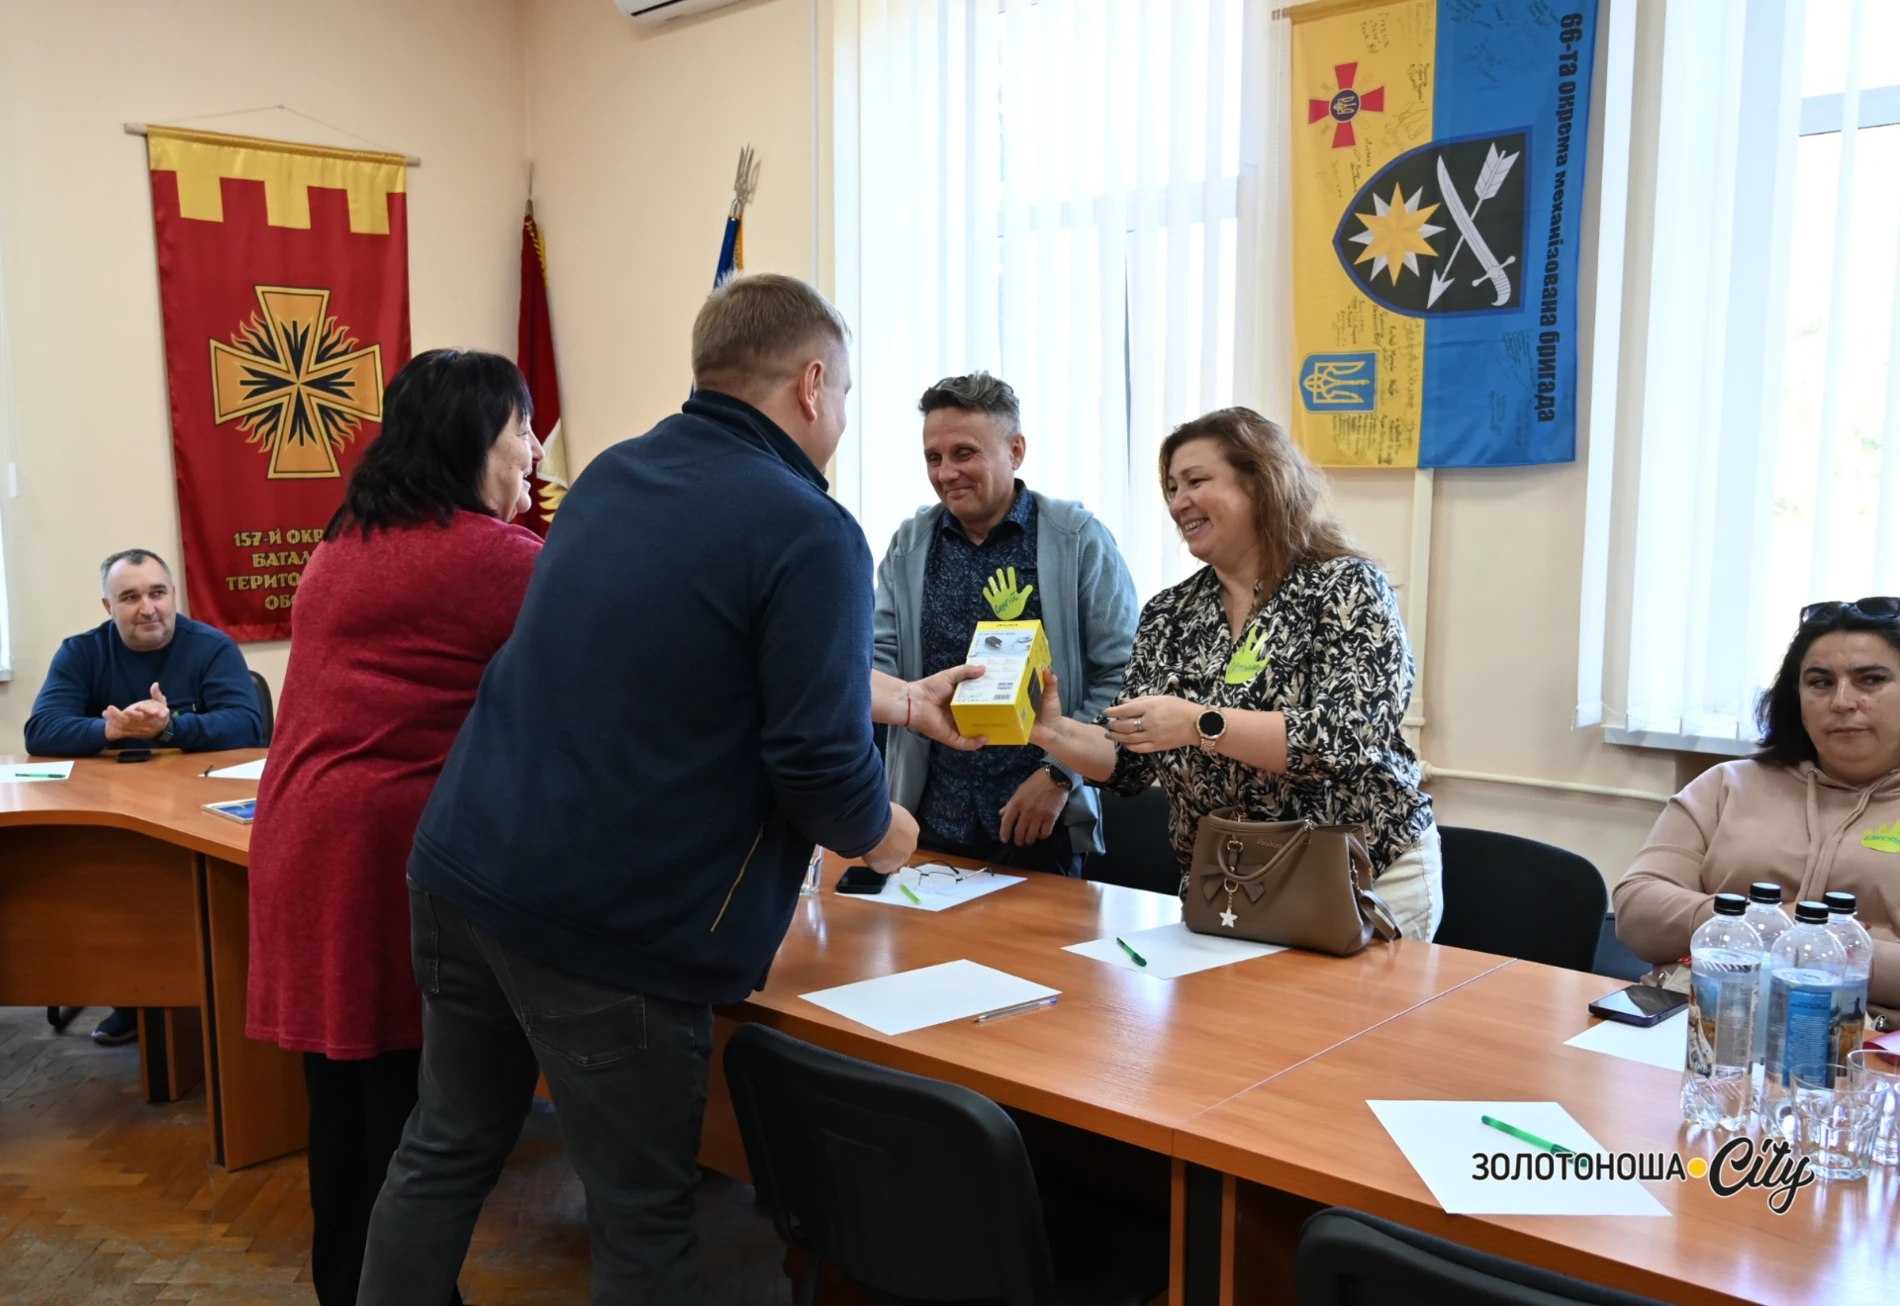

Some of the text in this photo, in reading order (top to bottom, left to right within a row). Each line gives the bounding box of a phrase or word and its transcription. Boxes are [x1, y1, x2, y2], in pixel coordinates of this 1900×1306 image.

[1558, 13, 1583, 77] 66-та
[1555, 81, 1577, 168] окрема
[1539, 170, 1567, 327] механізована
[1534, 331, 1560, 423] бригада
[233, 528, 325, 547] 157-Й ОКР
[252, 550, 311, 568] БАТАЛ
[225, 571, 301, 591] ТЕРИТО
[264, 594, 296, 610] ОБ
